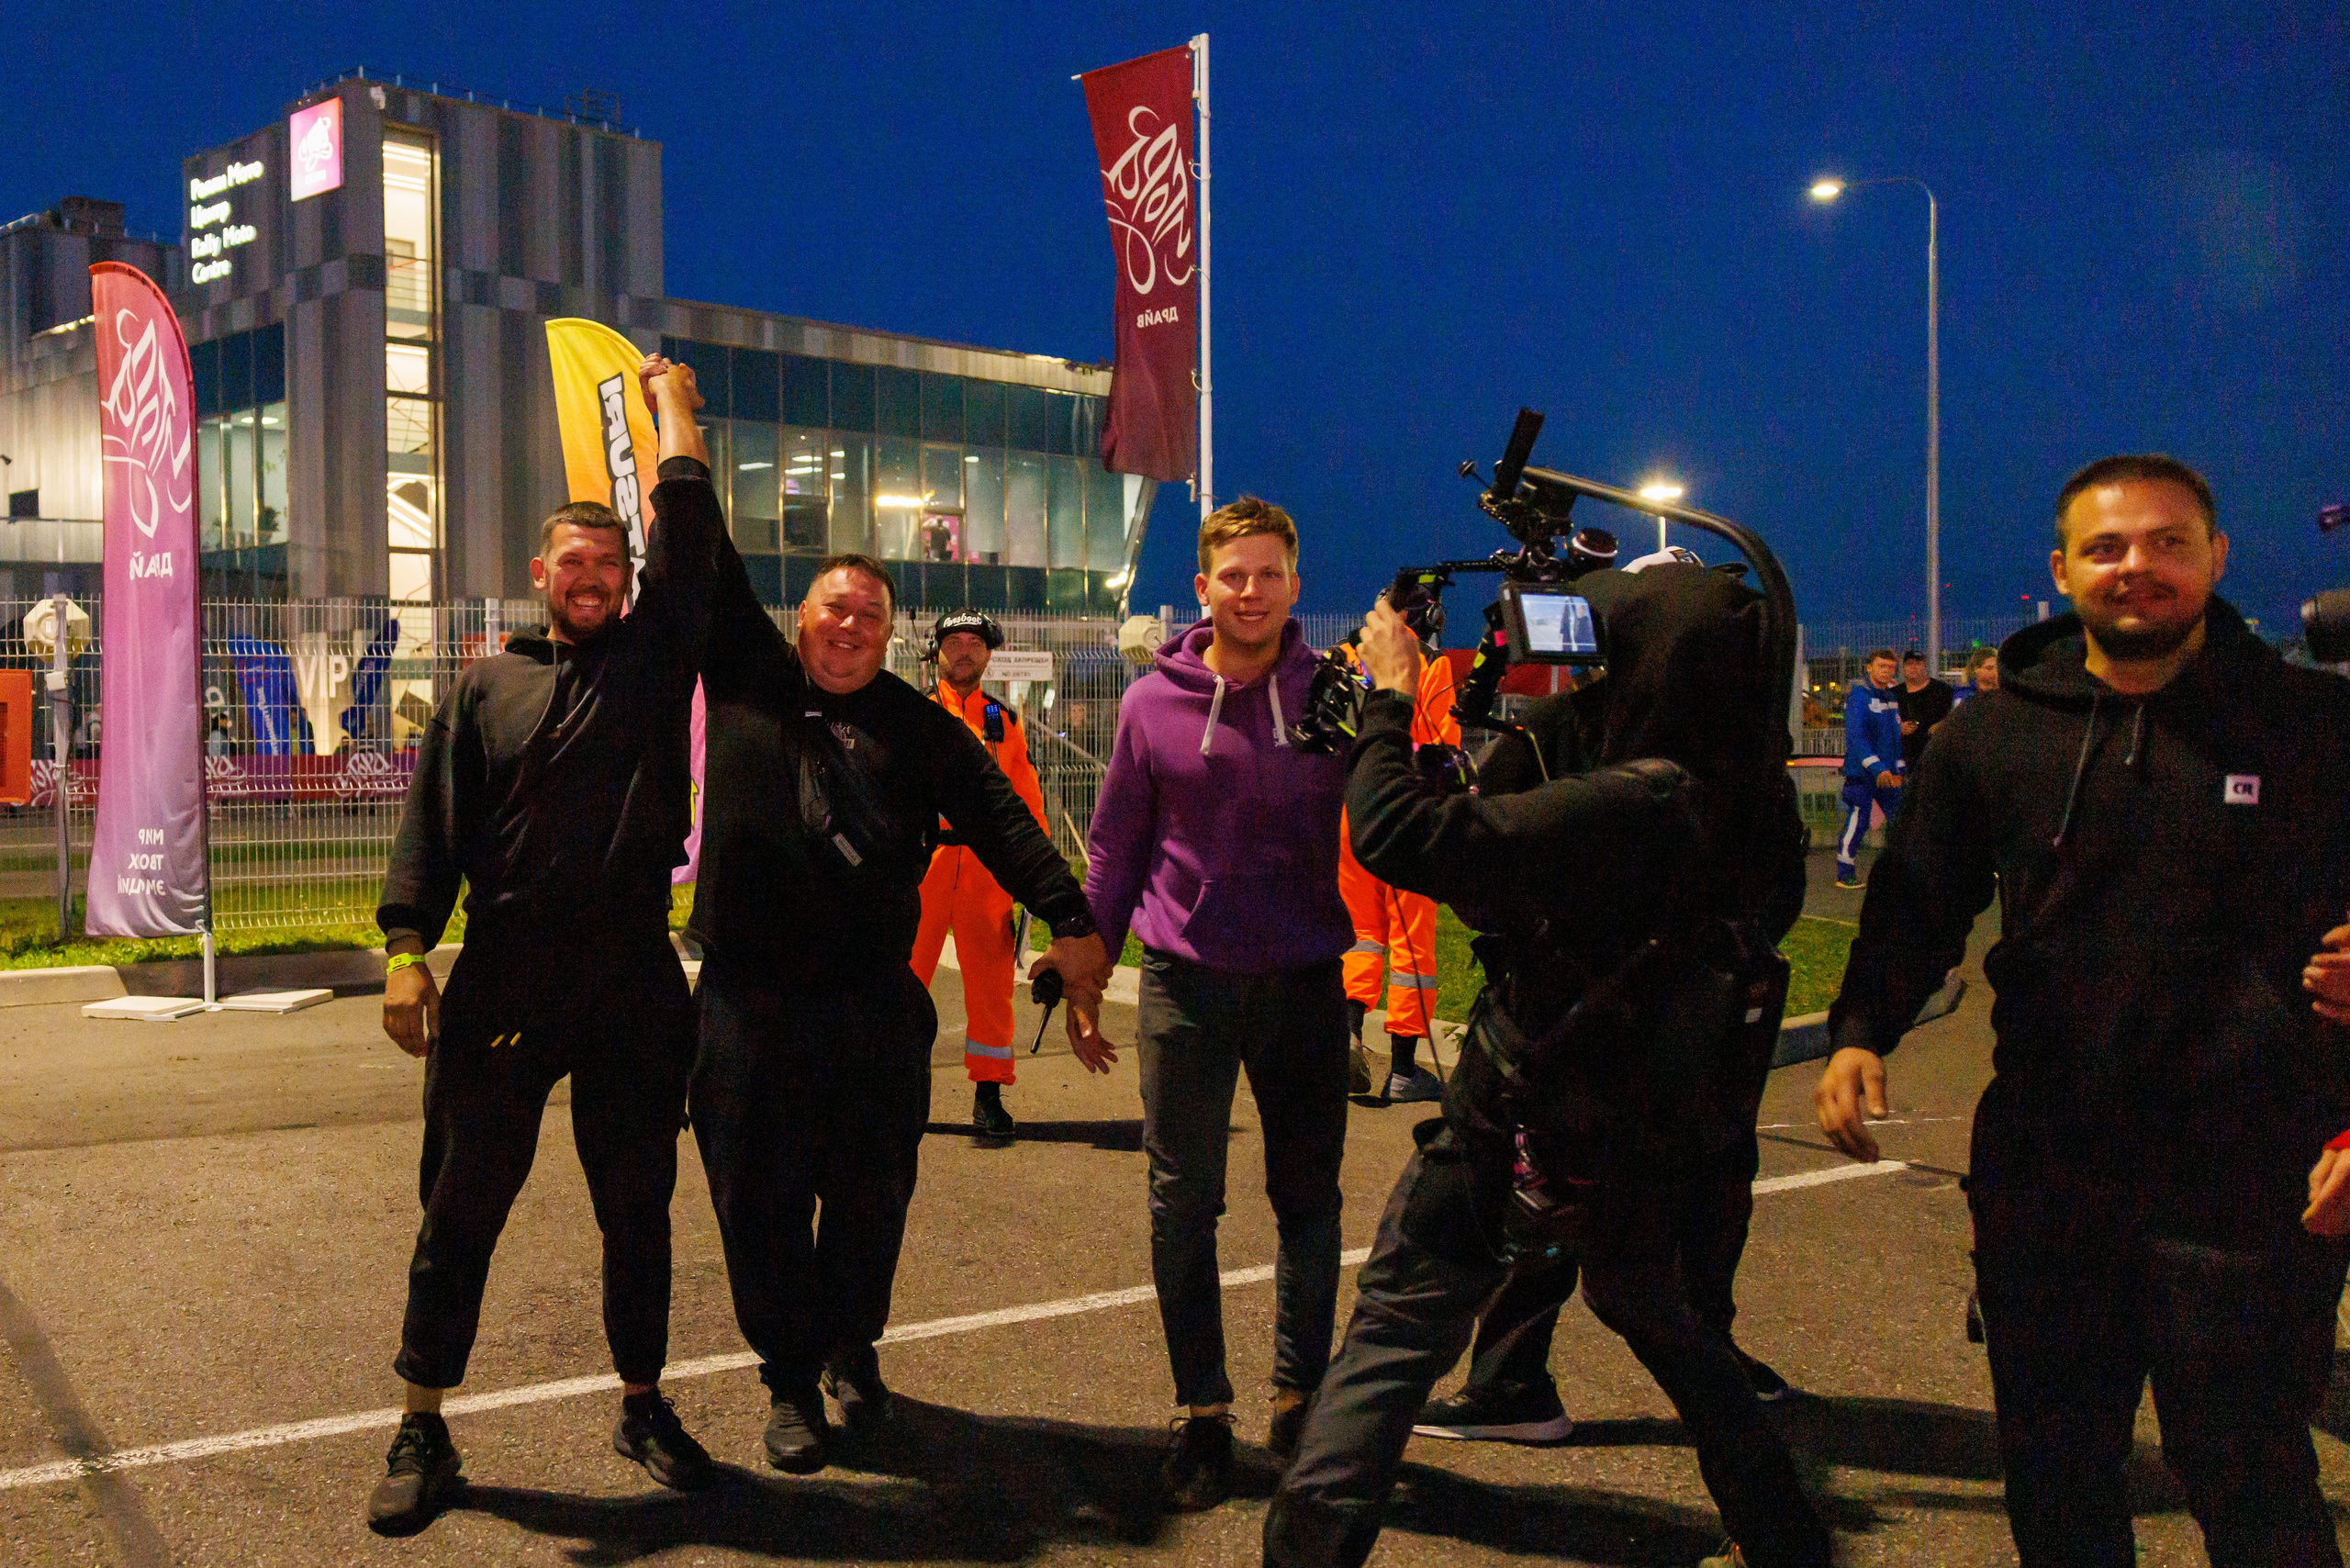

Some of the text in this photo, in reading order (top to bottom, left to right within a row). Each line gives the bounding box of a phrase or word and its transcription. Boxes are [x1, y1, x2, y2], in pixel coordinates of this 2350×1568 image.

[227, 161, 263, 187] Мото
[191, 201, 230, 229] Центр
[191, 225, 256, 259] Rally Moto
[192, 259, 231, 284] Centre
[297, 655, 348, 698] VIP
